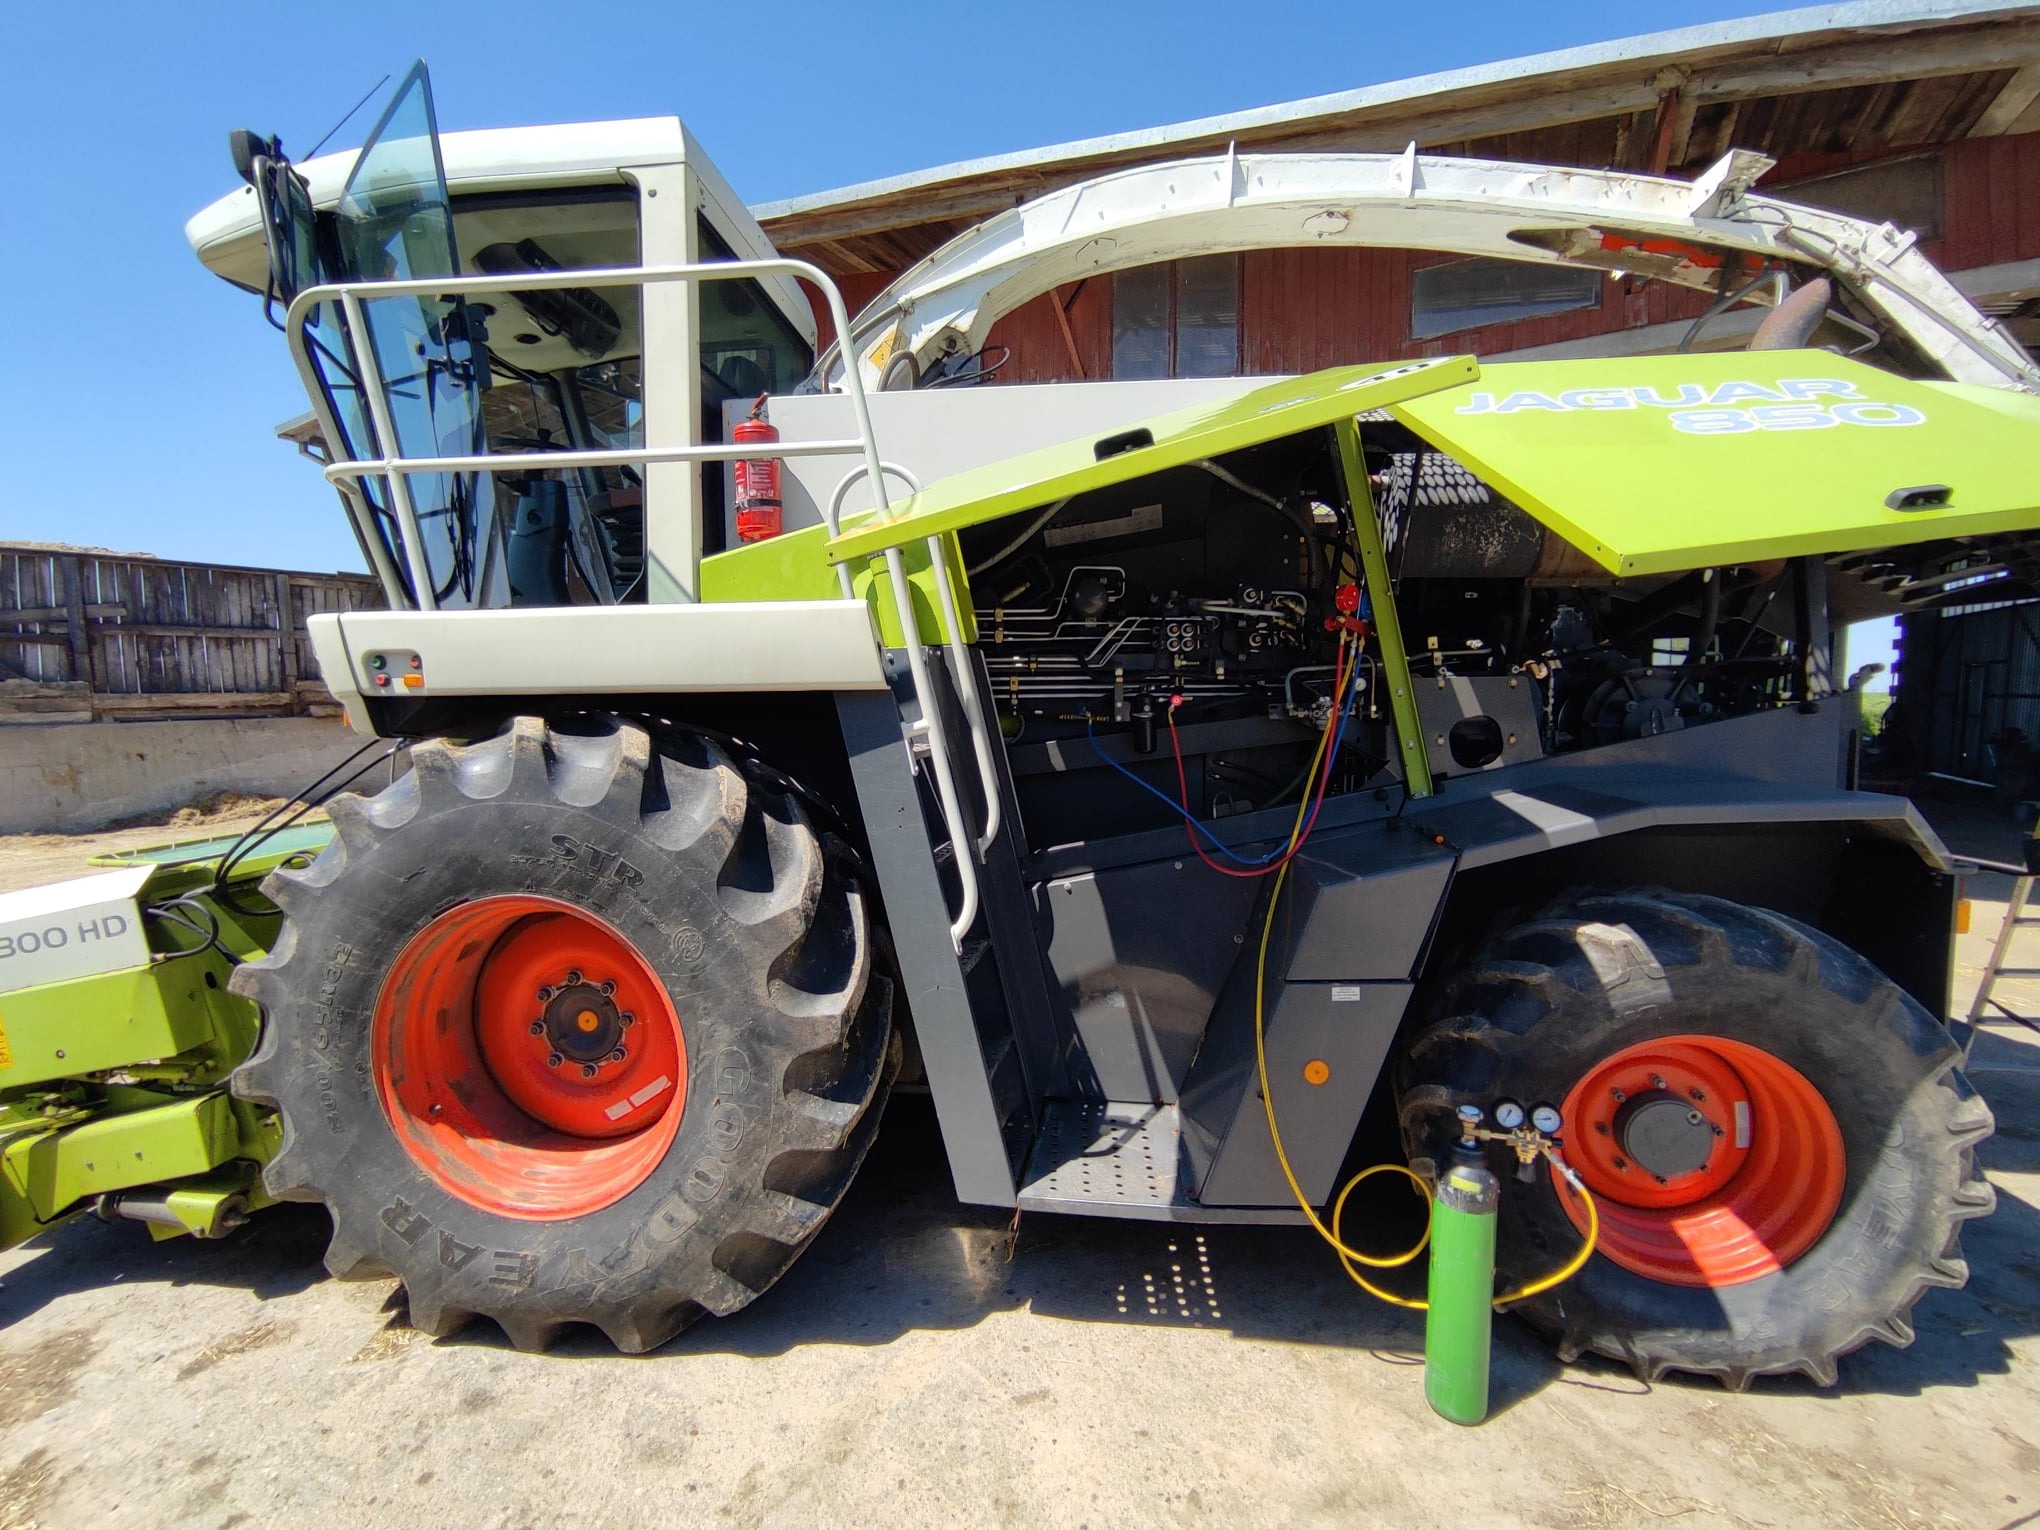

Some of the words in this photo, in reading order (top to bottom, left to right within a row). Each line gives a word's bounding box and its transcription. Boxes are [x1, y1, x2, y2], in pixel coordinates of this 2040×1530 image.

[1454, 377, 1869, 416] JAGUAR
[1669, 402, 1927, 435] 850
[551, 833, 646, 892] STR
[77, 914, 128, 943] HD
[379, 1046, 752, 1299] GOODYEAR
